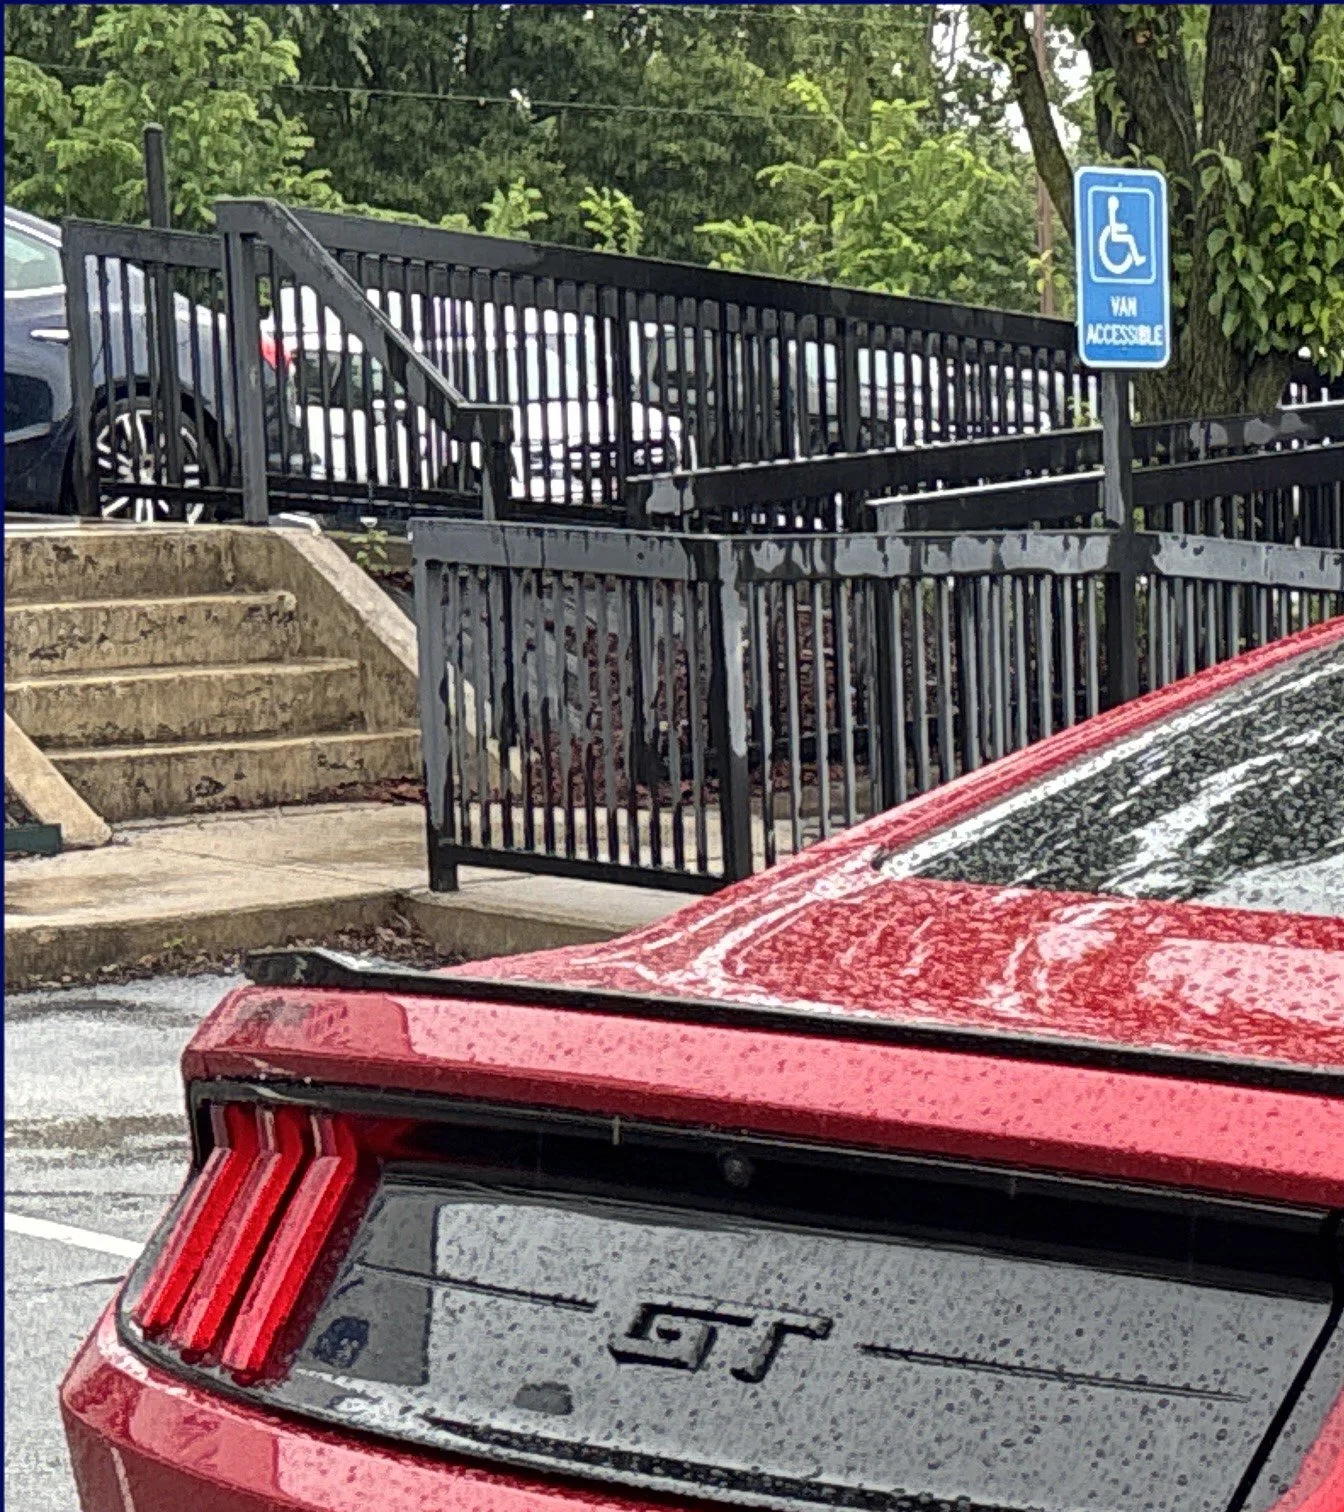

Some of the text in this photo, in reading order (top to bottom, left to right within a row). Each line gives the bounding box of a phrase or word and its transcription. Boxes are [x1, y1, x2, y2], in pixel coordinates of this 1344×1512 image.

[1110, 296, 1138, 317] VAN
[1086, 323, 1164, 346] ACCESSIBLE
[607, 1302, 834, 1384] GT
